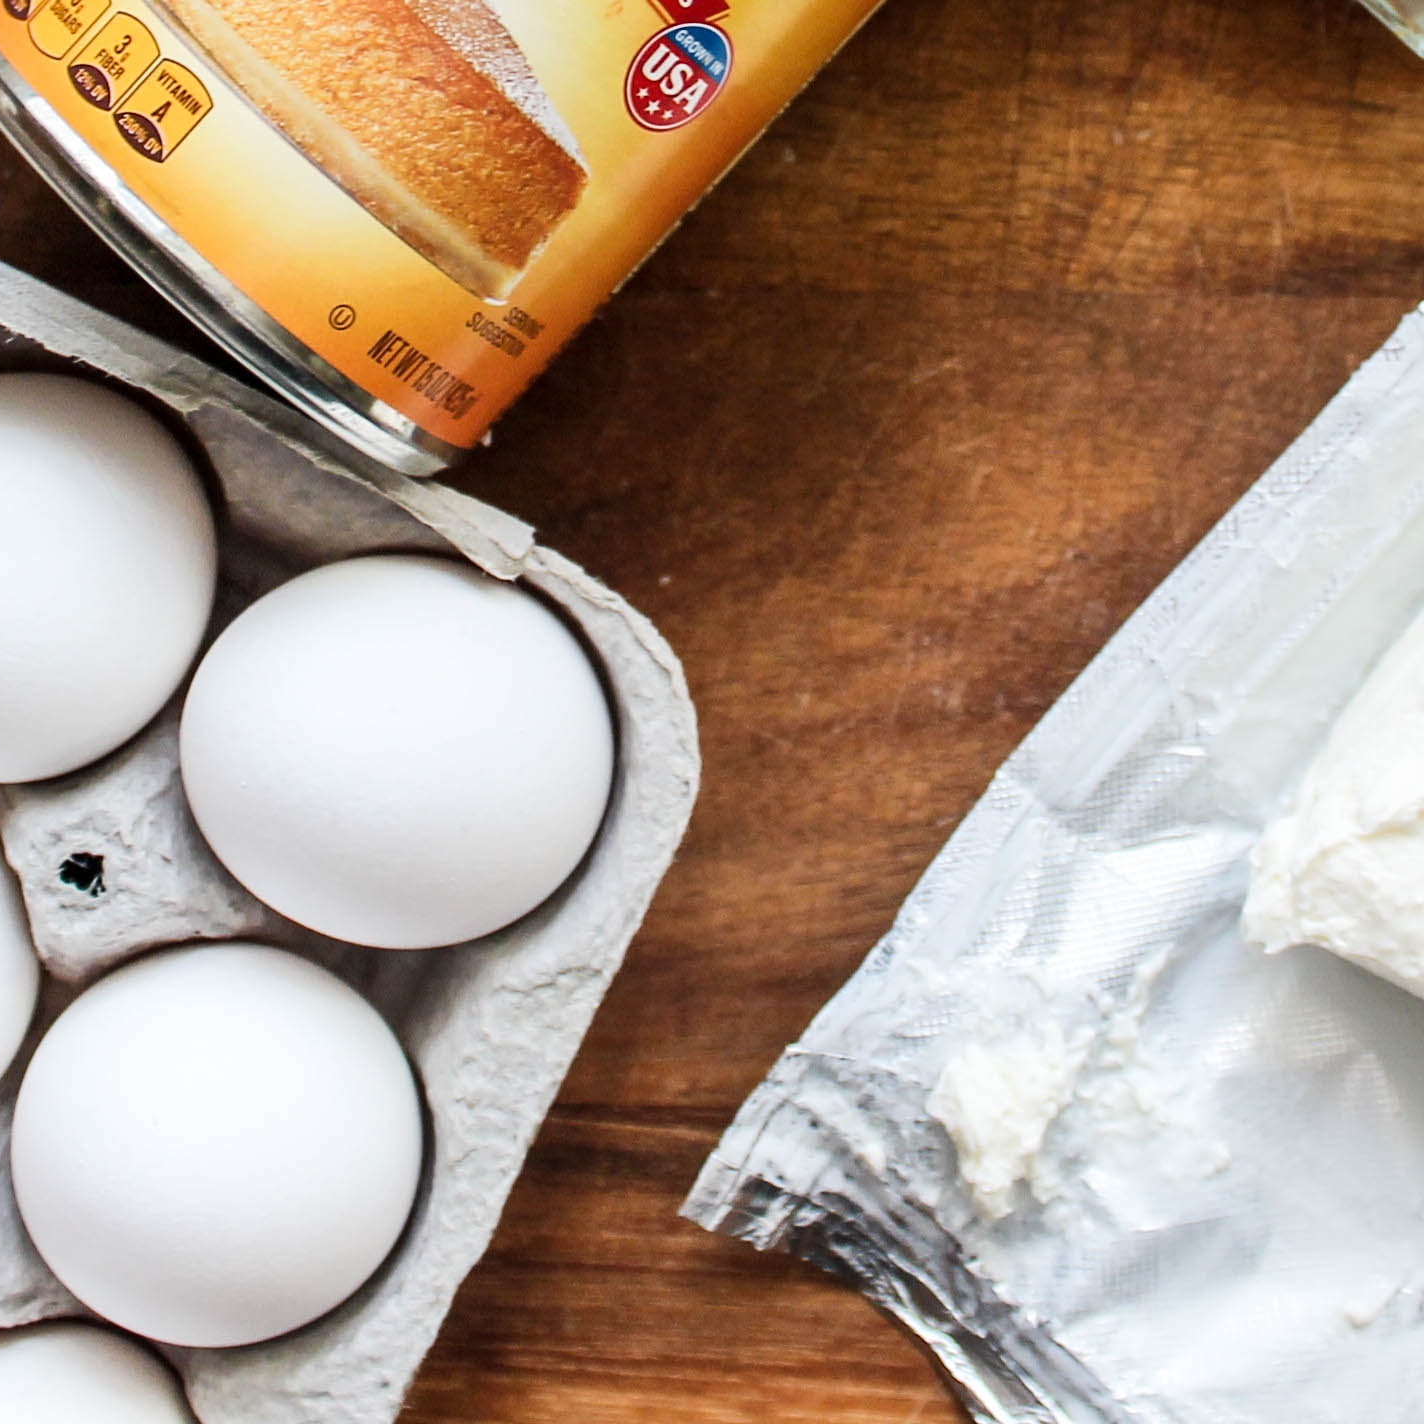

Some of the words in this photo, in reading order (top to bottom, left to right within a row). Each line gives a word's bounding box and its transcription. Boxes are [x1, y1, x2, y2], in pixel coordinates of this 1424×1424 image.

[93, 47, 127, 81] FIBER
[674, 29, 715, 67] GROWN
[154, 67, 204, 117] VITAMIN
[640, 42, 710, 115] USA
[150, 100, 173, 125] A
[142, 137, 164, 158] DV
[366, 329, 410, 369] NET
[391, 346, 430, 384] WT
